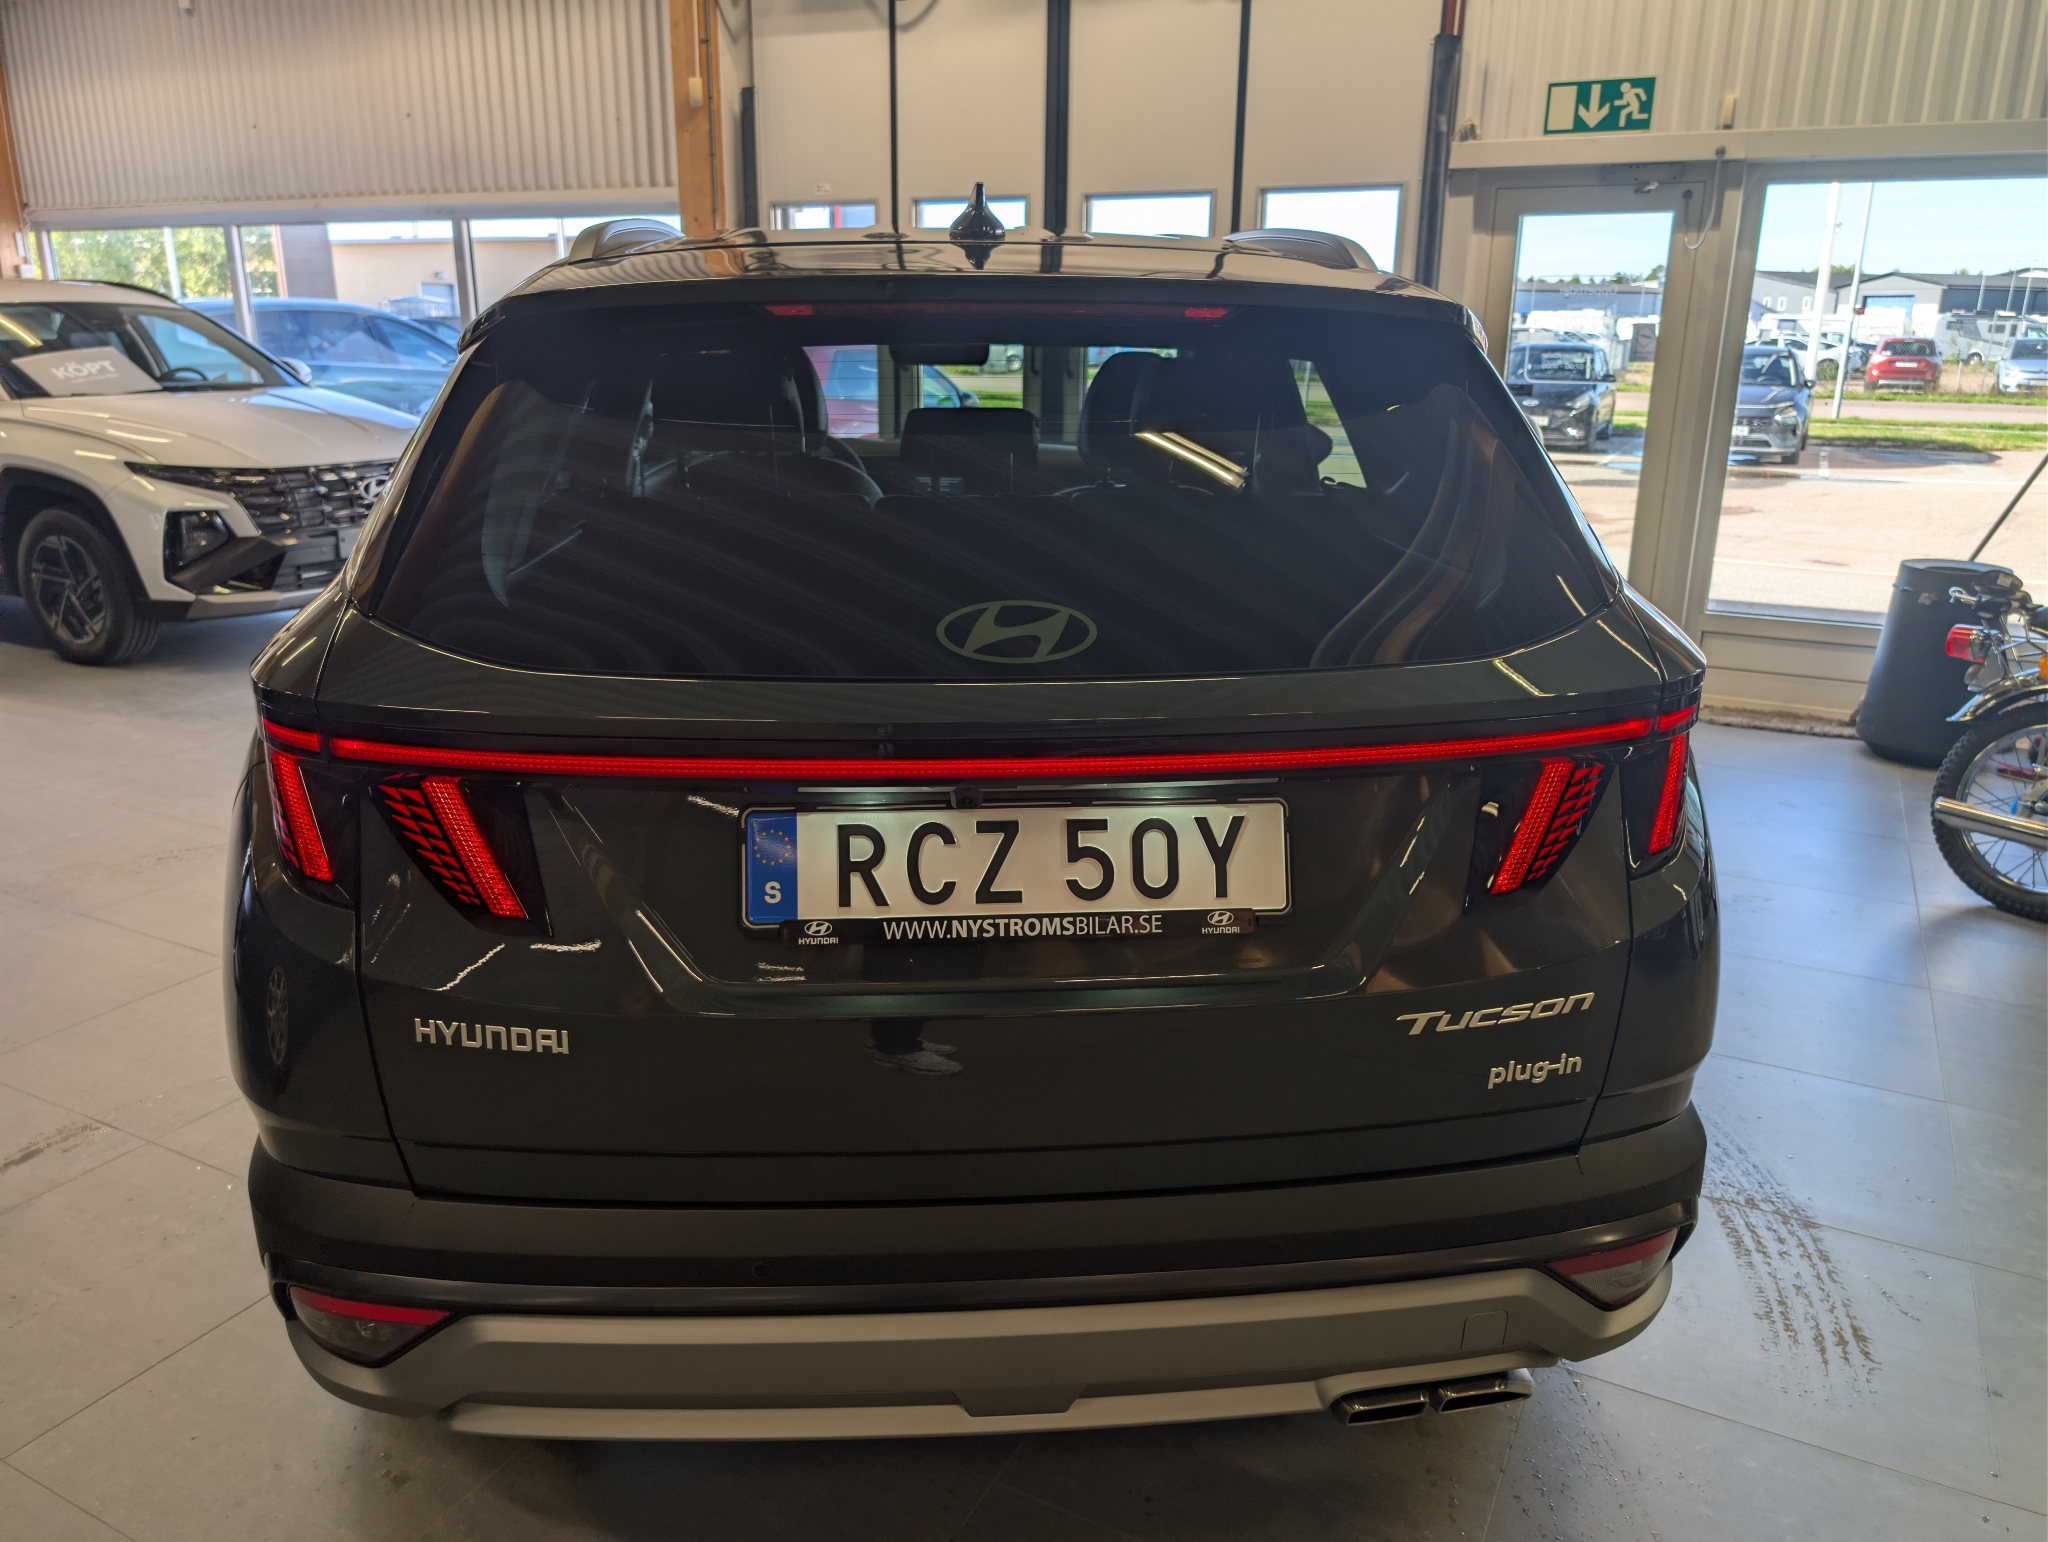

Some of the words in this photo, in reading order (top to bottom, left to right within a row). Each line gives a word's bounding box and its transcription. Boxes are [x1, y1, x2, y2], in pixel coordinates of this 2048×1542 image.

[51, 359, 117, 379] KÖPT
[837, 820, 1023, 907] RCZ
[1065, 816, 1245, 901] 50Y
[764, 881, 782, 904] S
[883, 915, 1163, 940] WWW.NYSTROMSBILAR.SE
[1202, 926, 1240, 934] HYUNDAI
[798, 937, 839, 945] HYUNDAI
[1396, 991, 1595, 1036] TUCSON
[414, 1017, 570, 1055] HYUNDAI
[1487, 1052, 1583, 1090] plug-in
